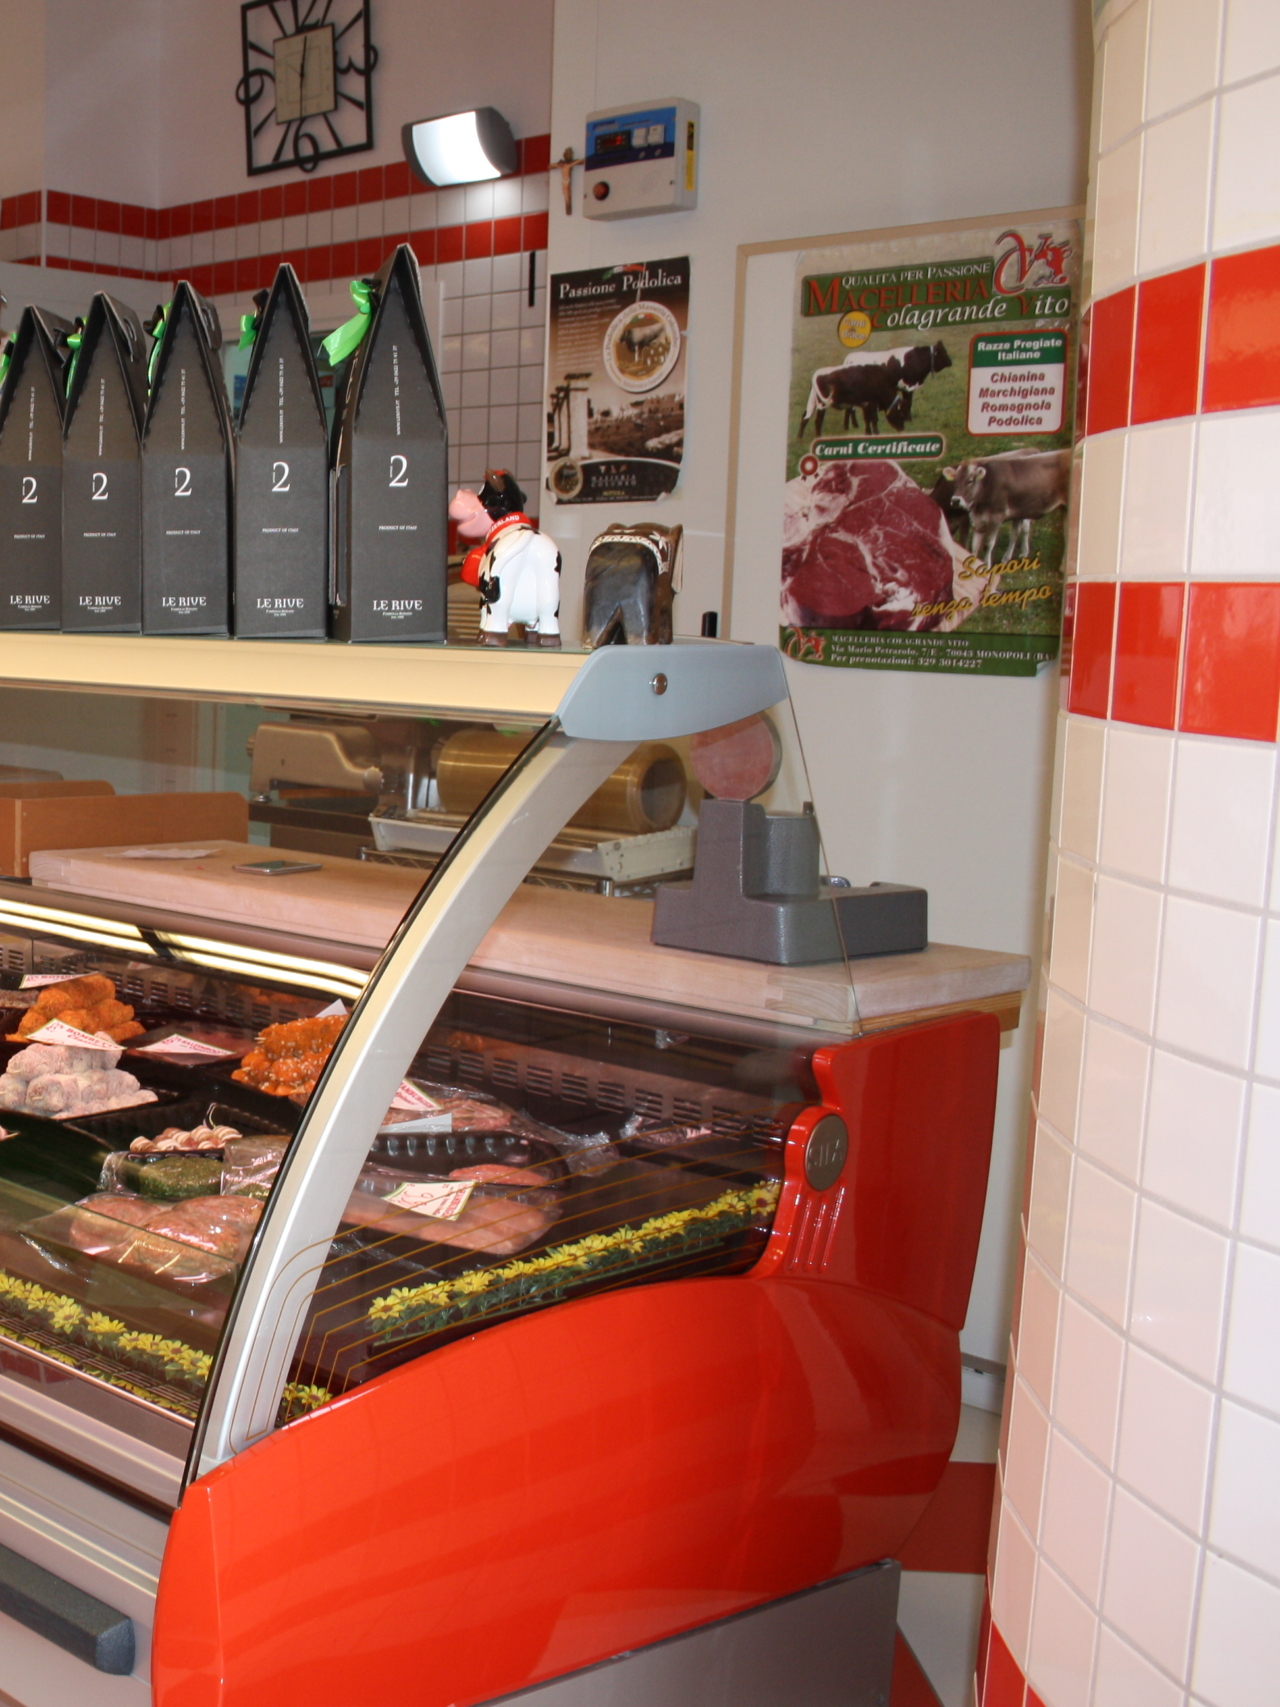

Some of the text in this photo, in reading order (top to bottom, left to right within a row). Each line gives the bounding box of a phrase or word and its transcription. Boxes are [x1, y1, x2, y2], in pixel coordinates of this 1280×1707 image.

[900, 269, 923, 282] PER
[927, 262, 991, 279] PASSIONE
[559, 268, 682, 299] Passione Podolica
[807, 277, 989, 315] MACELLERIA
[872, 295, 1069, 331] Colagrande Vito
[977, 338, 1062, 351] Razze Pregiate
[997, 350, 1040, 361] Italiane
[990, 371, 1045, 384] Chianina
[978, 386, 1055, 400] Marchigiana
[980, 401, 1051, 415] Romagnola
[987, 415, 1043, 428] Podolica
[815, 440, 940, 456] Carni Certificate
[272, 462, 290, 492] 2
[389, 455, 409, 487] 2
[92, 473, 108, 500] 2
[175, 467, 192, 496] 2
[22, 477, 38, 503] 2
[958, 553, 1041, 585] Sapori
[10, 595, 50, 604] LE RIVE
[79, 596, 121, 605] LE RIVE
[162, 597, 206, 606] LE RIVE
[257, 599, 304, 609] LE RIVE
[373, 600, 422, 611] LE RIVE
[911, 584, 1052, 621] senza tempo
[832, 635, 969, 647] MACELLERIA COLAGRANDE VITO
[830, 644, 844, 653] Via
[847, 645, 872, 654] Mario
[976, 650, 1030, 660] MONOPOLI
[830, 653, 846, 662] Per
[849, 655, 915, 665] prenotazioni:
